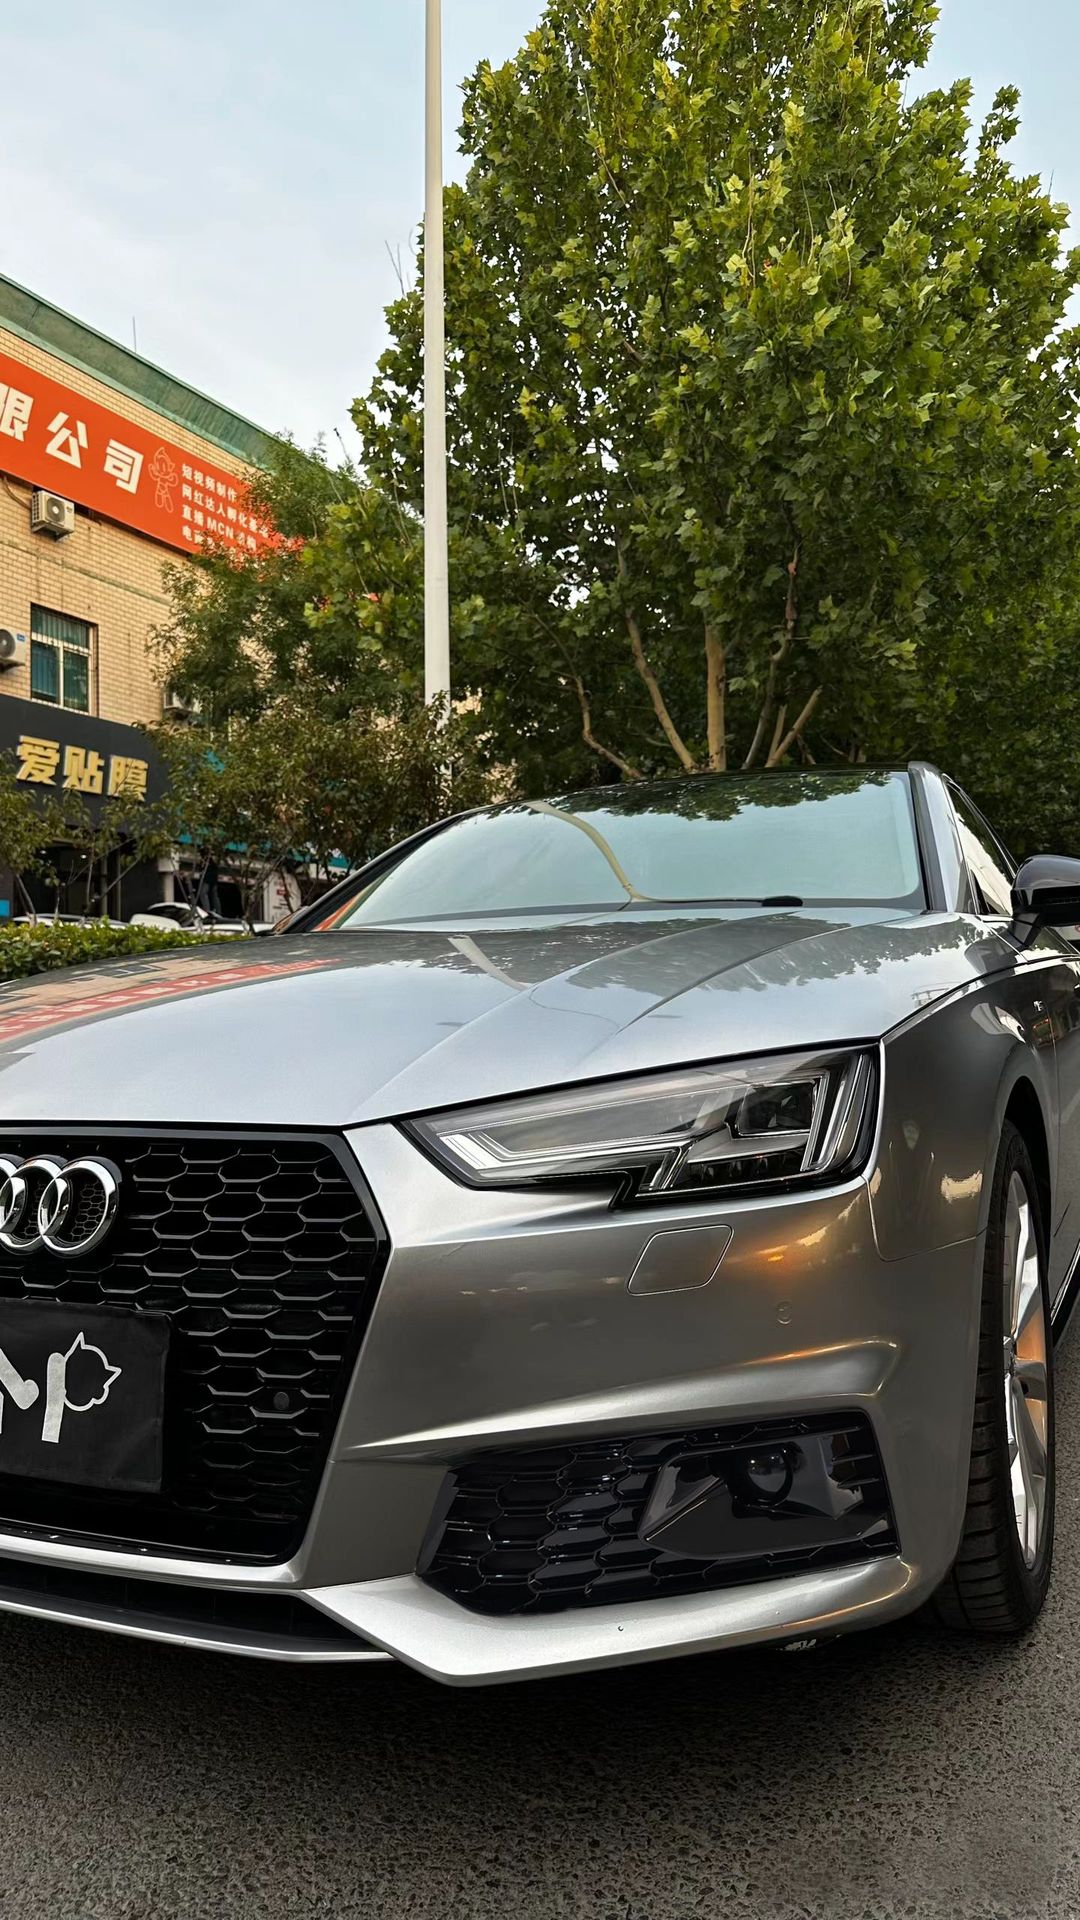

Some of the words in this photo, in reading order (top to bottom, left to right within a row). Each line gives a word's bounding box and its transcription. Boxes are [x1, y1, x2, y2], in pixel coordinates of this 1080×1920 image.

[182, 463, 238, 503] 短视频制作
[16, 735, 149, 801] 爱贴膜
